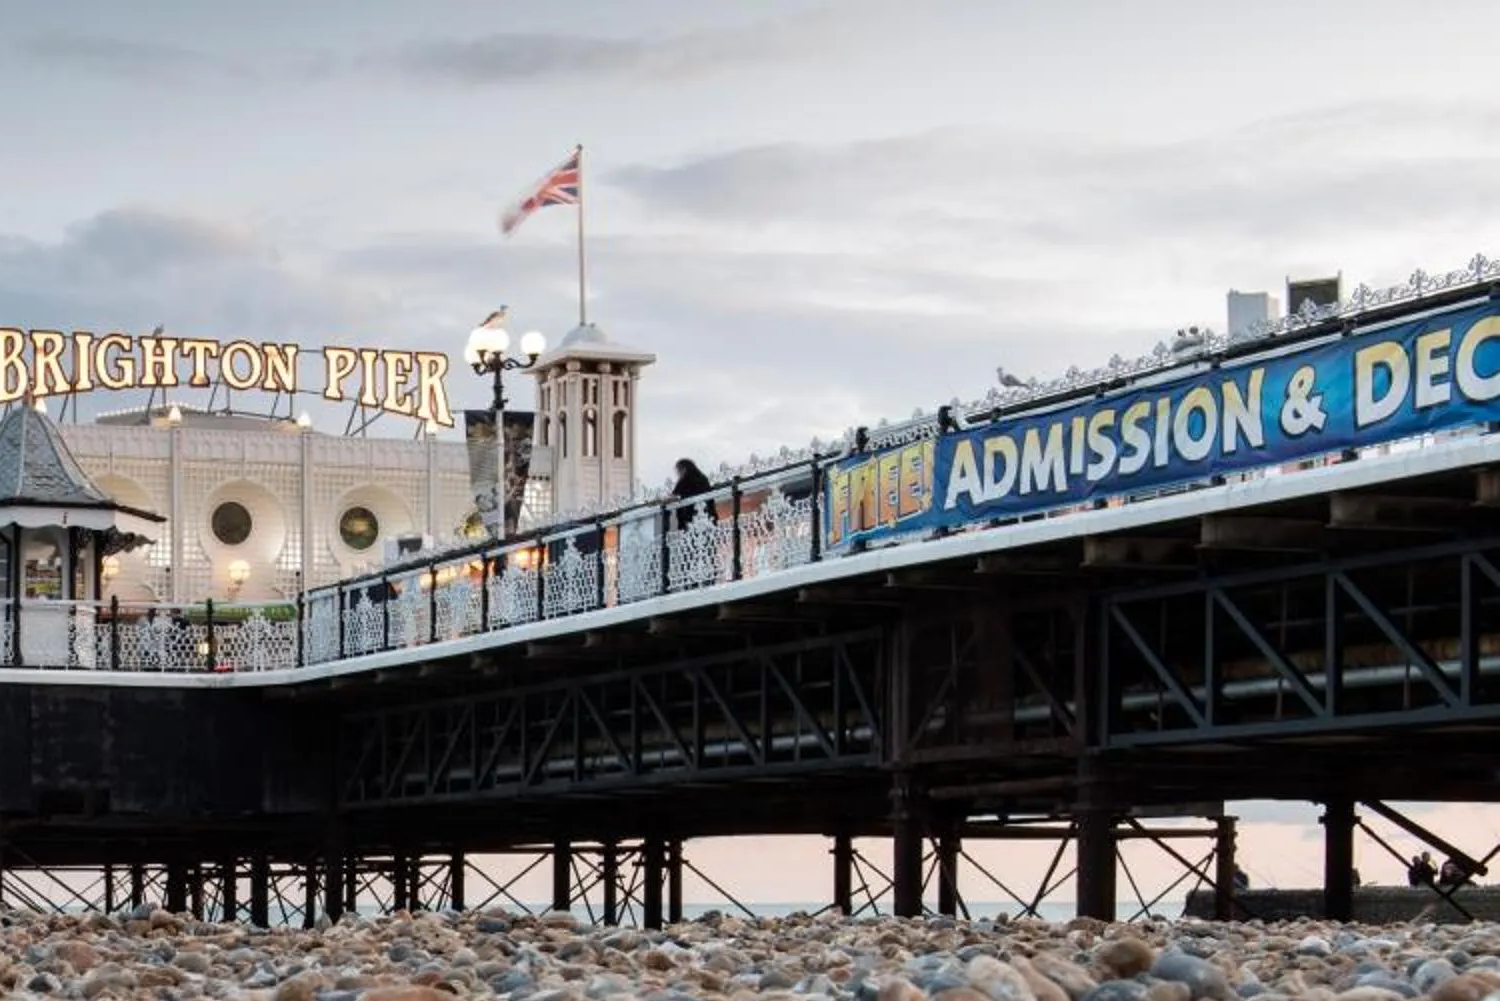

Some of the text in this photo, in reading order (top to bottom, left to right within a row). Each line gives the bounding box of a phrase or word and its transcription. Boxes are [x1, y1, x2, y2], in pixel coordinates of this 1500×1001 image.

[324, 346, 454, 427] PIER
[943, 367, 1265, 510] ADMISSION
[1280, 365, 1327, 435] &
[1355, 315, 1500, 427] DEC
